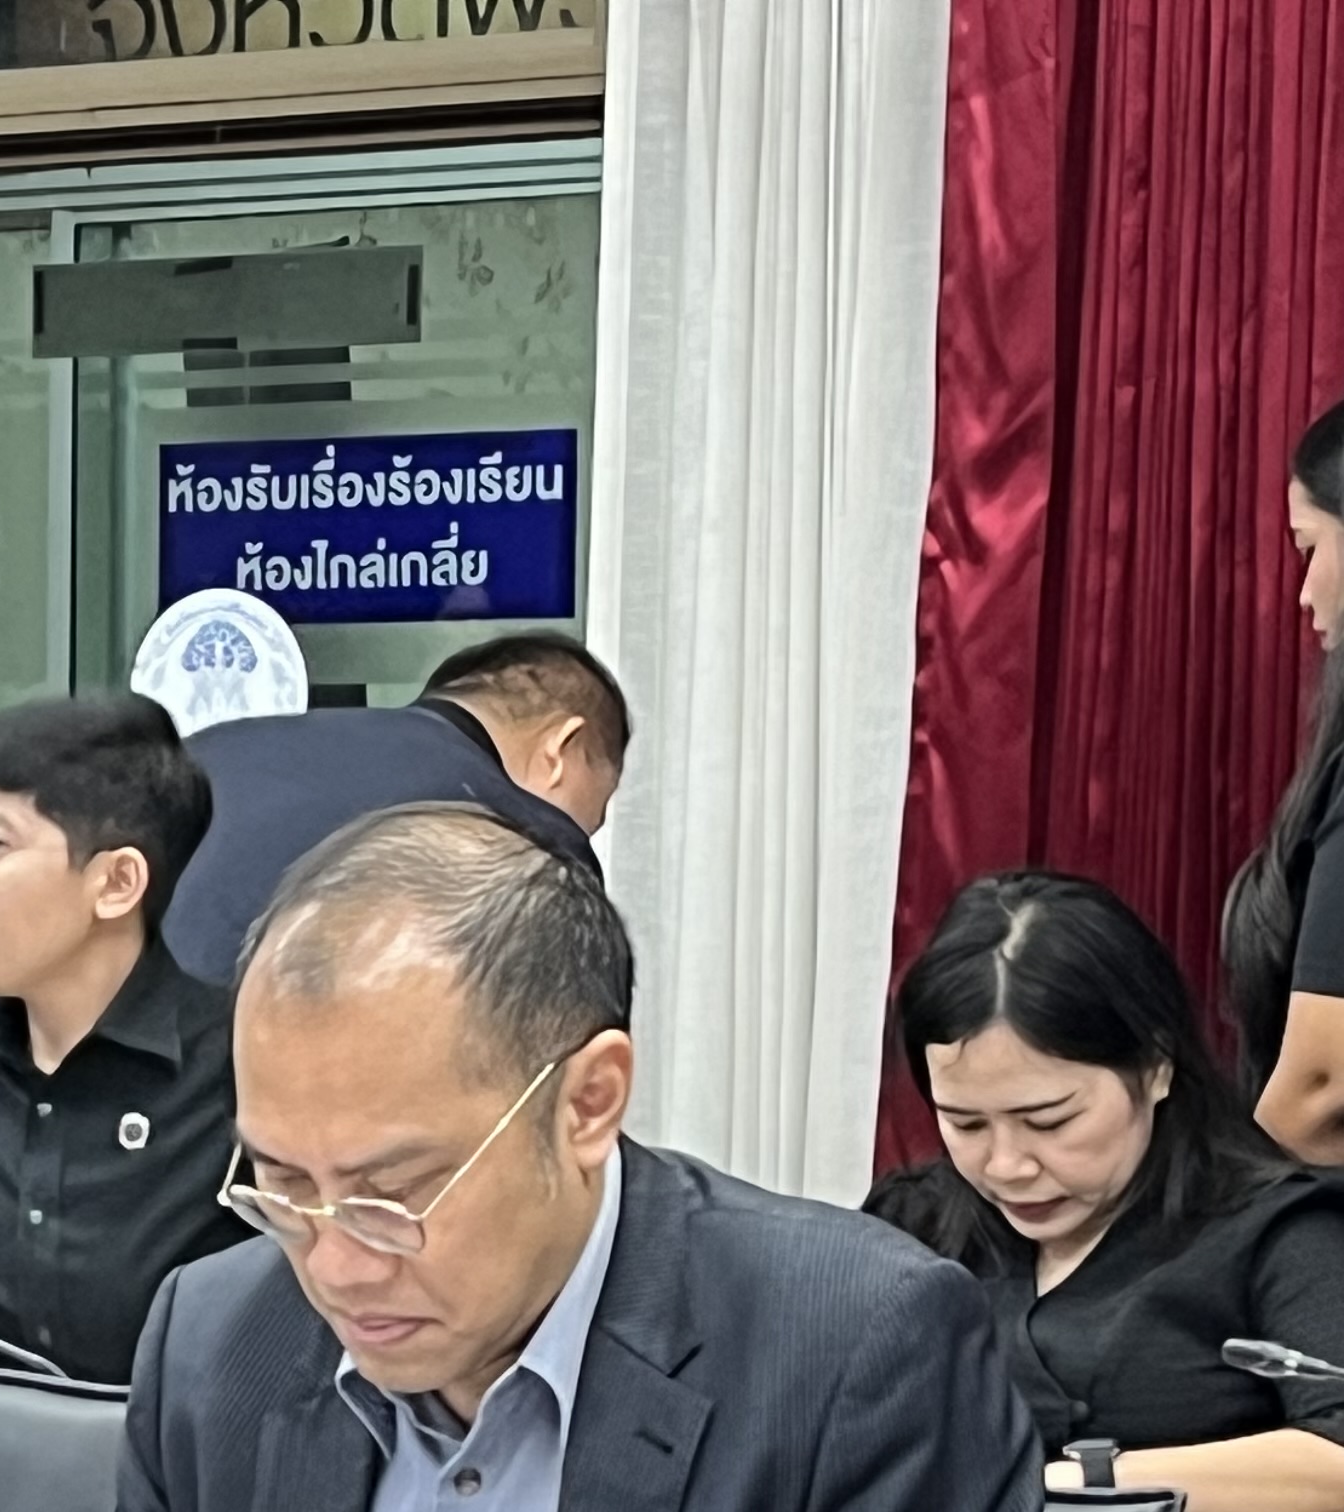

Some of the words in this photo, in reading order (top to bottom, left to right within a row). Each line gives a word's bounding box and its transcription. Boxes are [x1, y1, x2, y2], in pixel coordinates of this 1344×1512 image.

[168, 445, 564, 513] ห้องรับเรื่องร้องเรียน
[237, 521, 489, 591] ห้องไกล่เกลี่ย
